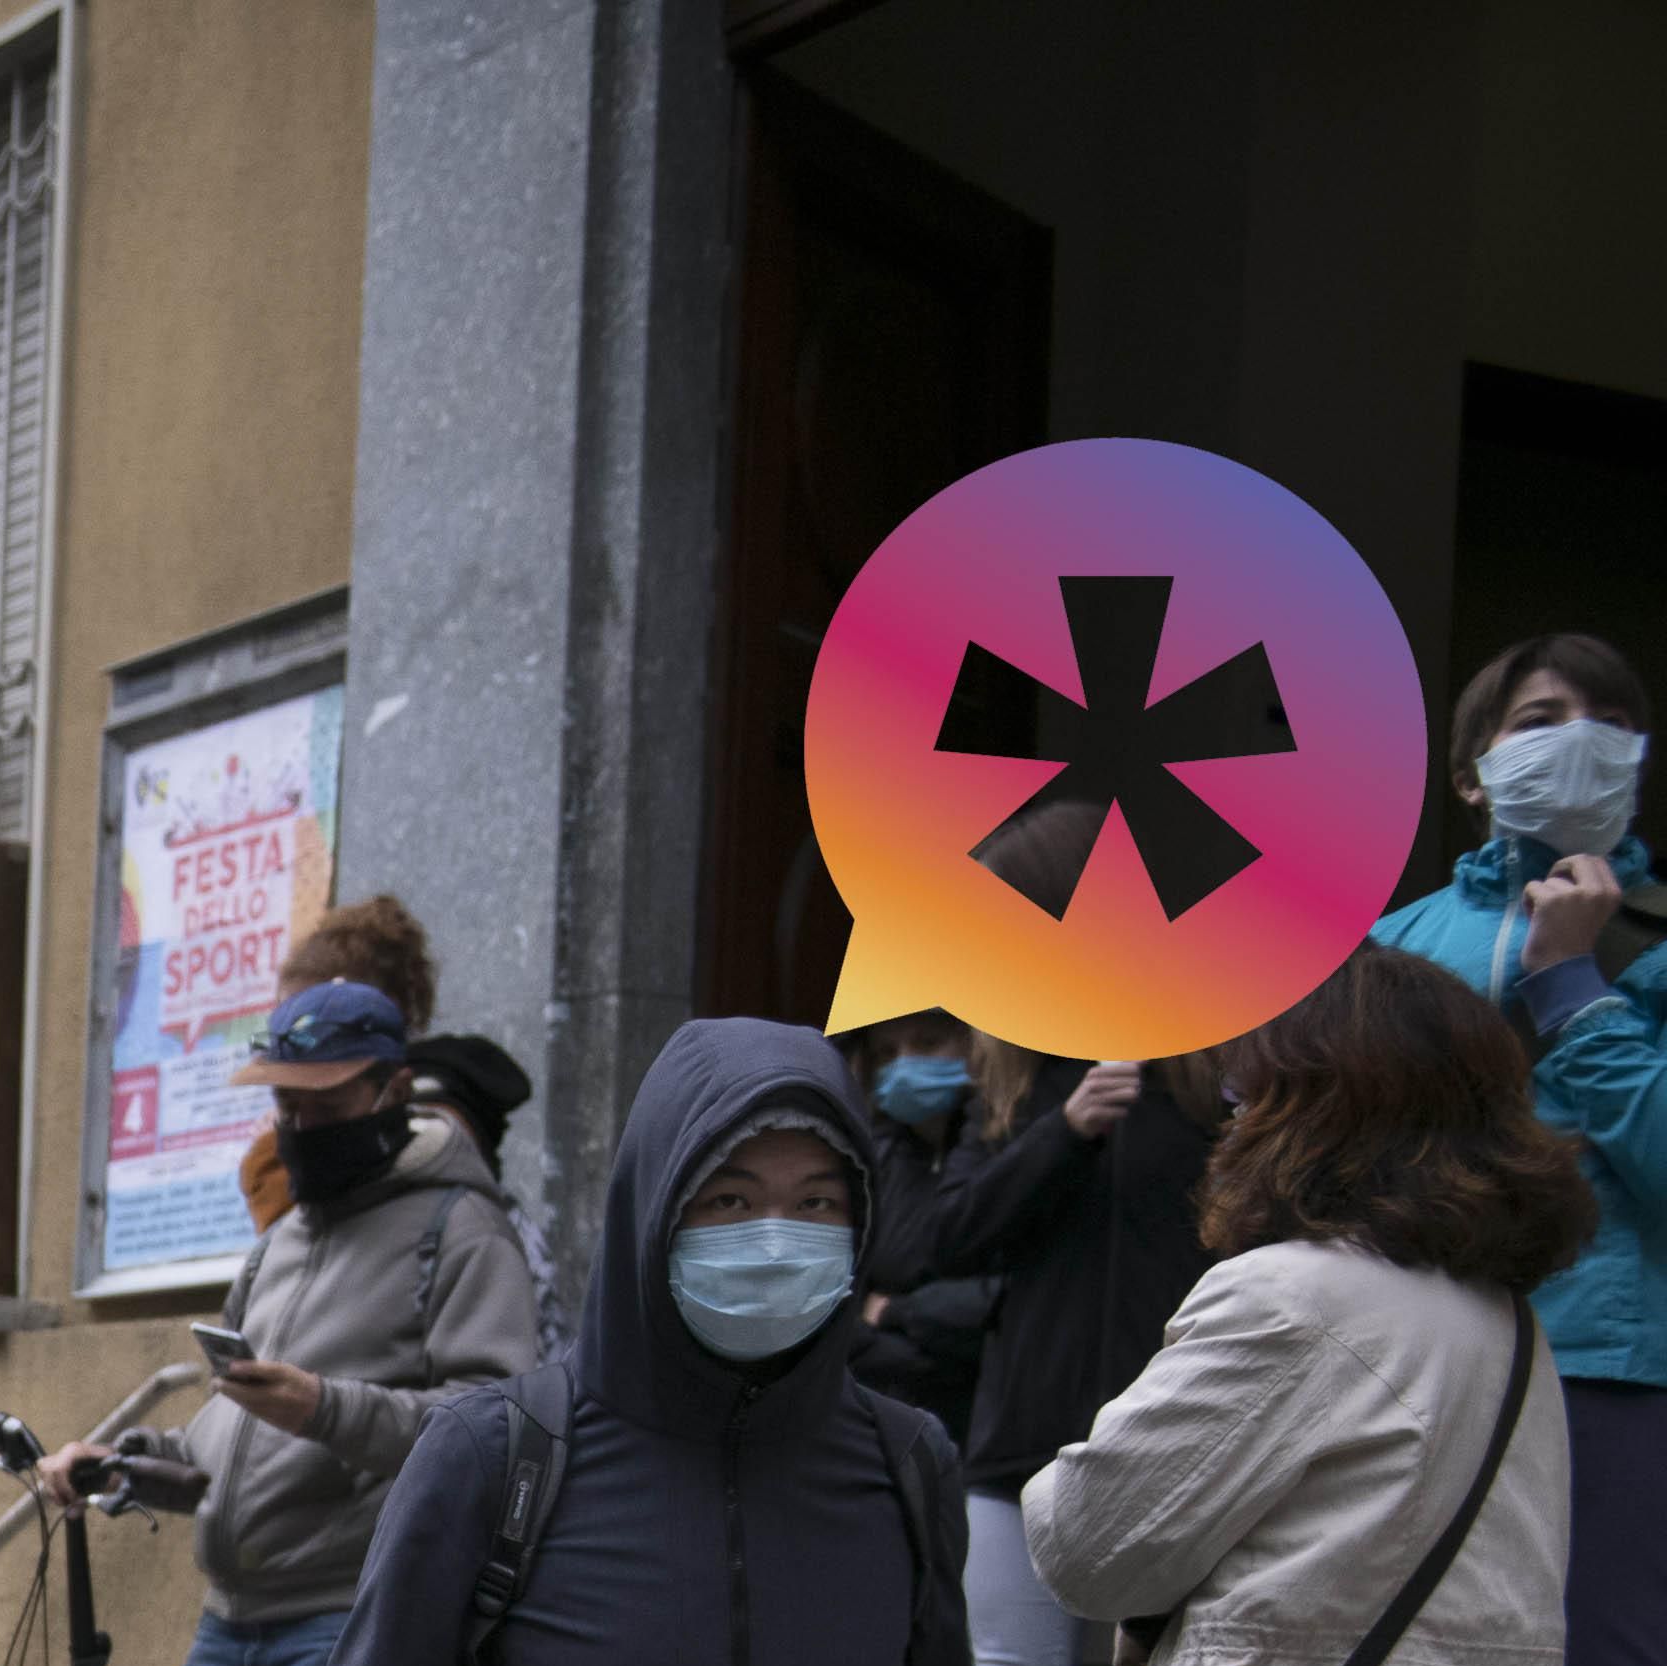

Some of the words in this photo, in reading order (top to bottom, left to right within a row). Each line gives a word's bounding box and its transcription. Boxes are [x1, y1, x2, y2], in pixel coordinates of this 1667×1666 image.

[173, 831, 285, 901] FESTA
[184, 888, 268, 941] DELLO
[164, 926, 285, 997] SPORT
[122, 1092, 144, 1135] 4
